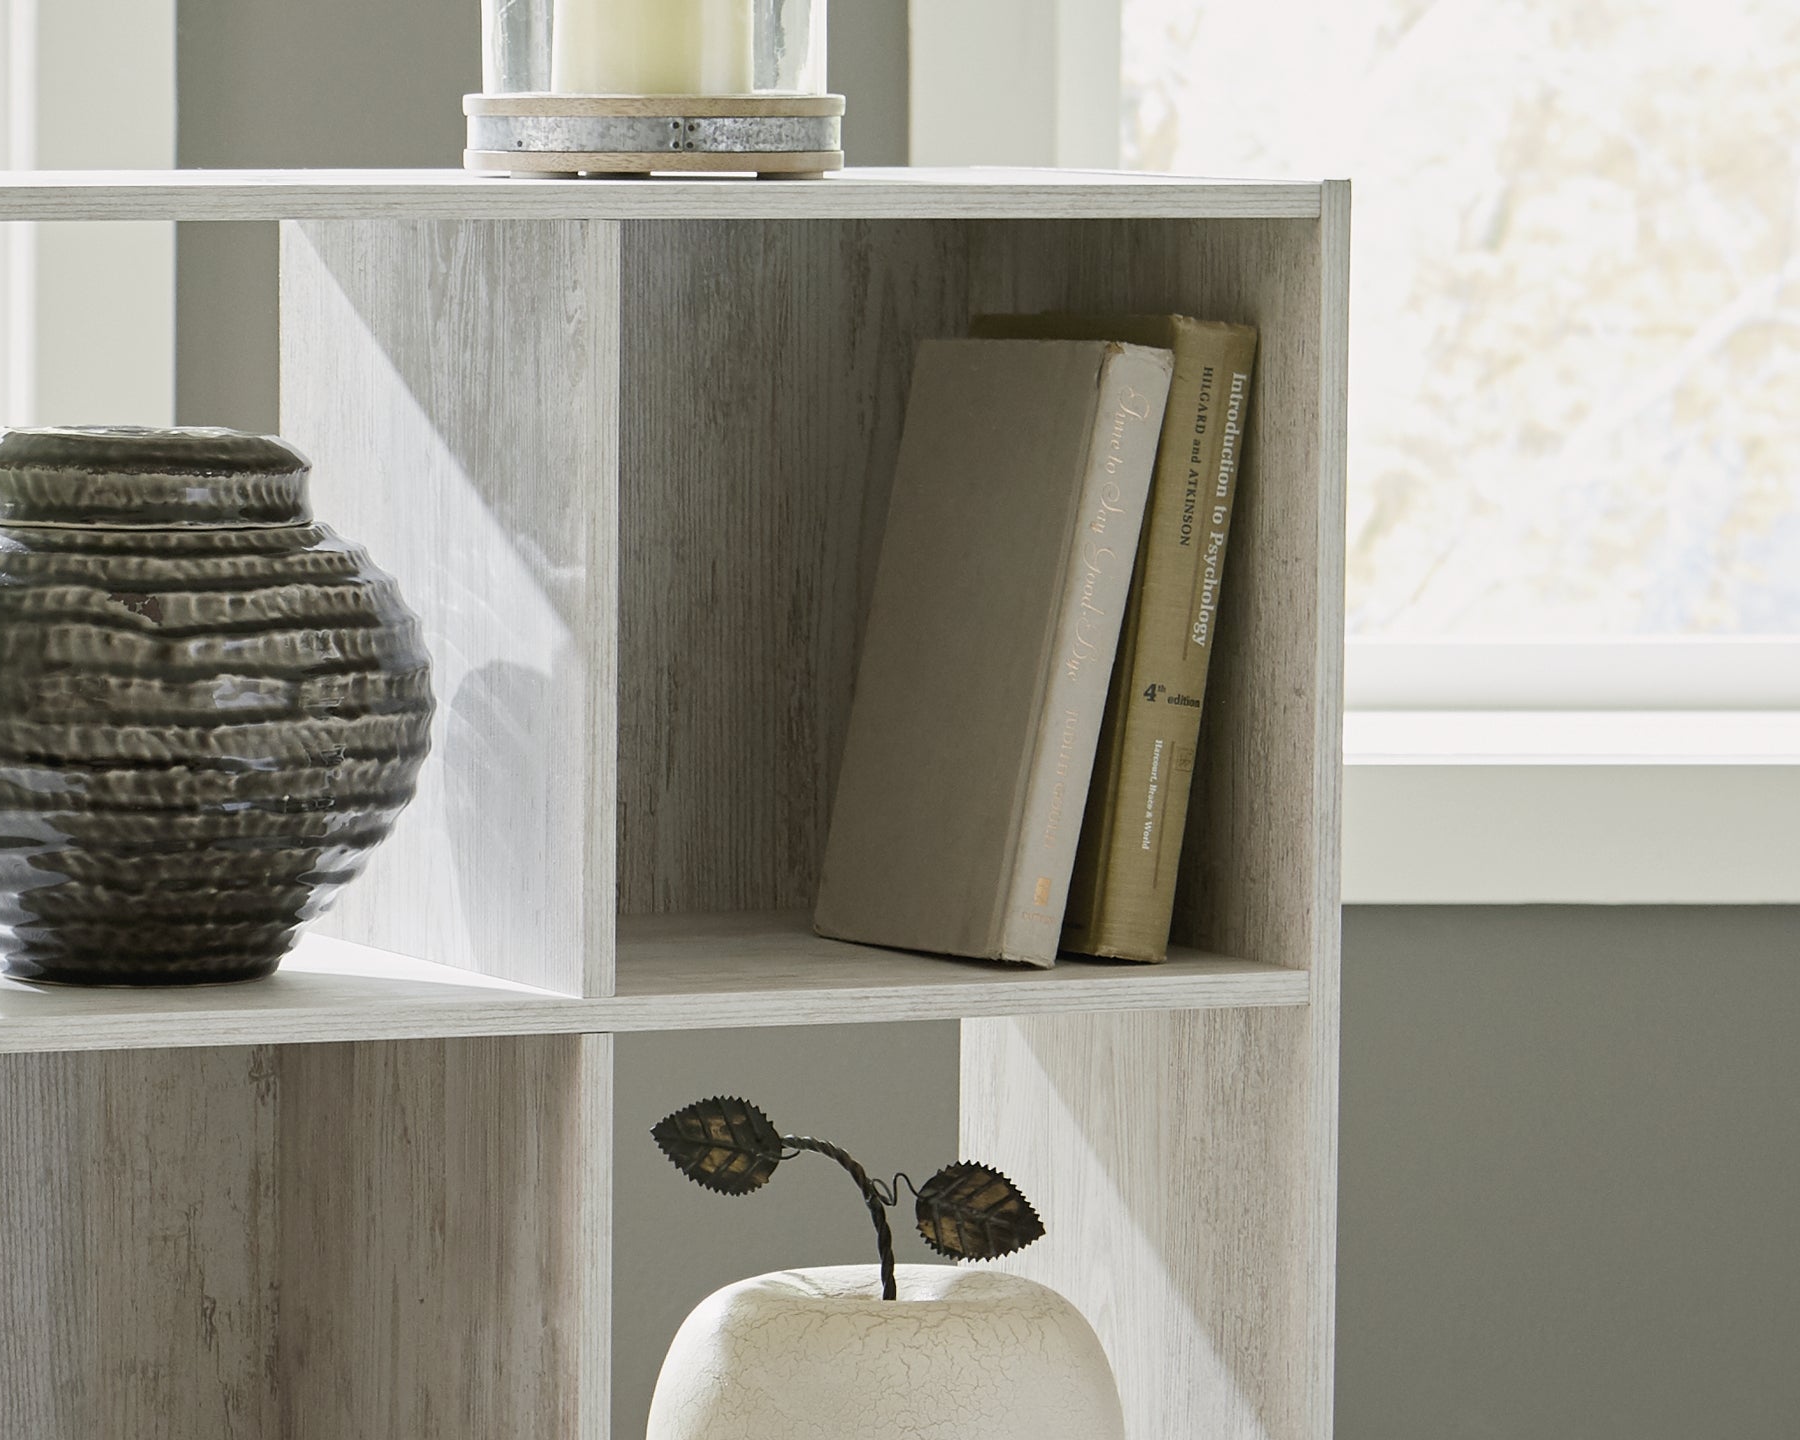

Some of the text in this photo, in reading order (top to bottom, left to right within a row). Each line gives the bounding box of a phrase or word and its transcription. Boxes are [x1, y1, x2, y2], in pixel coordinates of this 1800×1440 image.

[1180, 366, 1214, 546] HILGARD and ATKINSON
[1192, 372, 1247, 647] Introduction to Psychology
[1167, 694, 1200, 708] edition
[1150, 739, 1164, 783] Harcourt,
[1142, 821, 1153, 850] World
